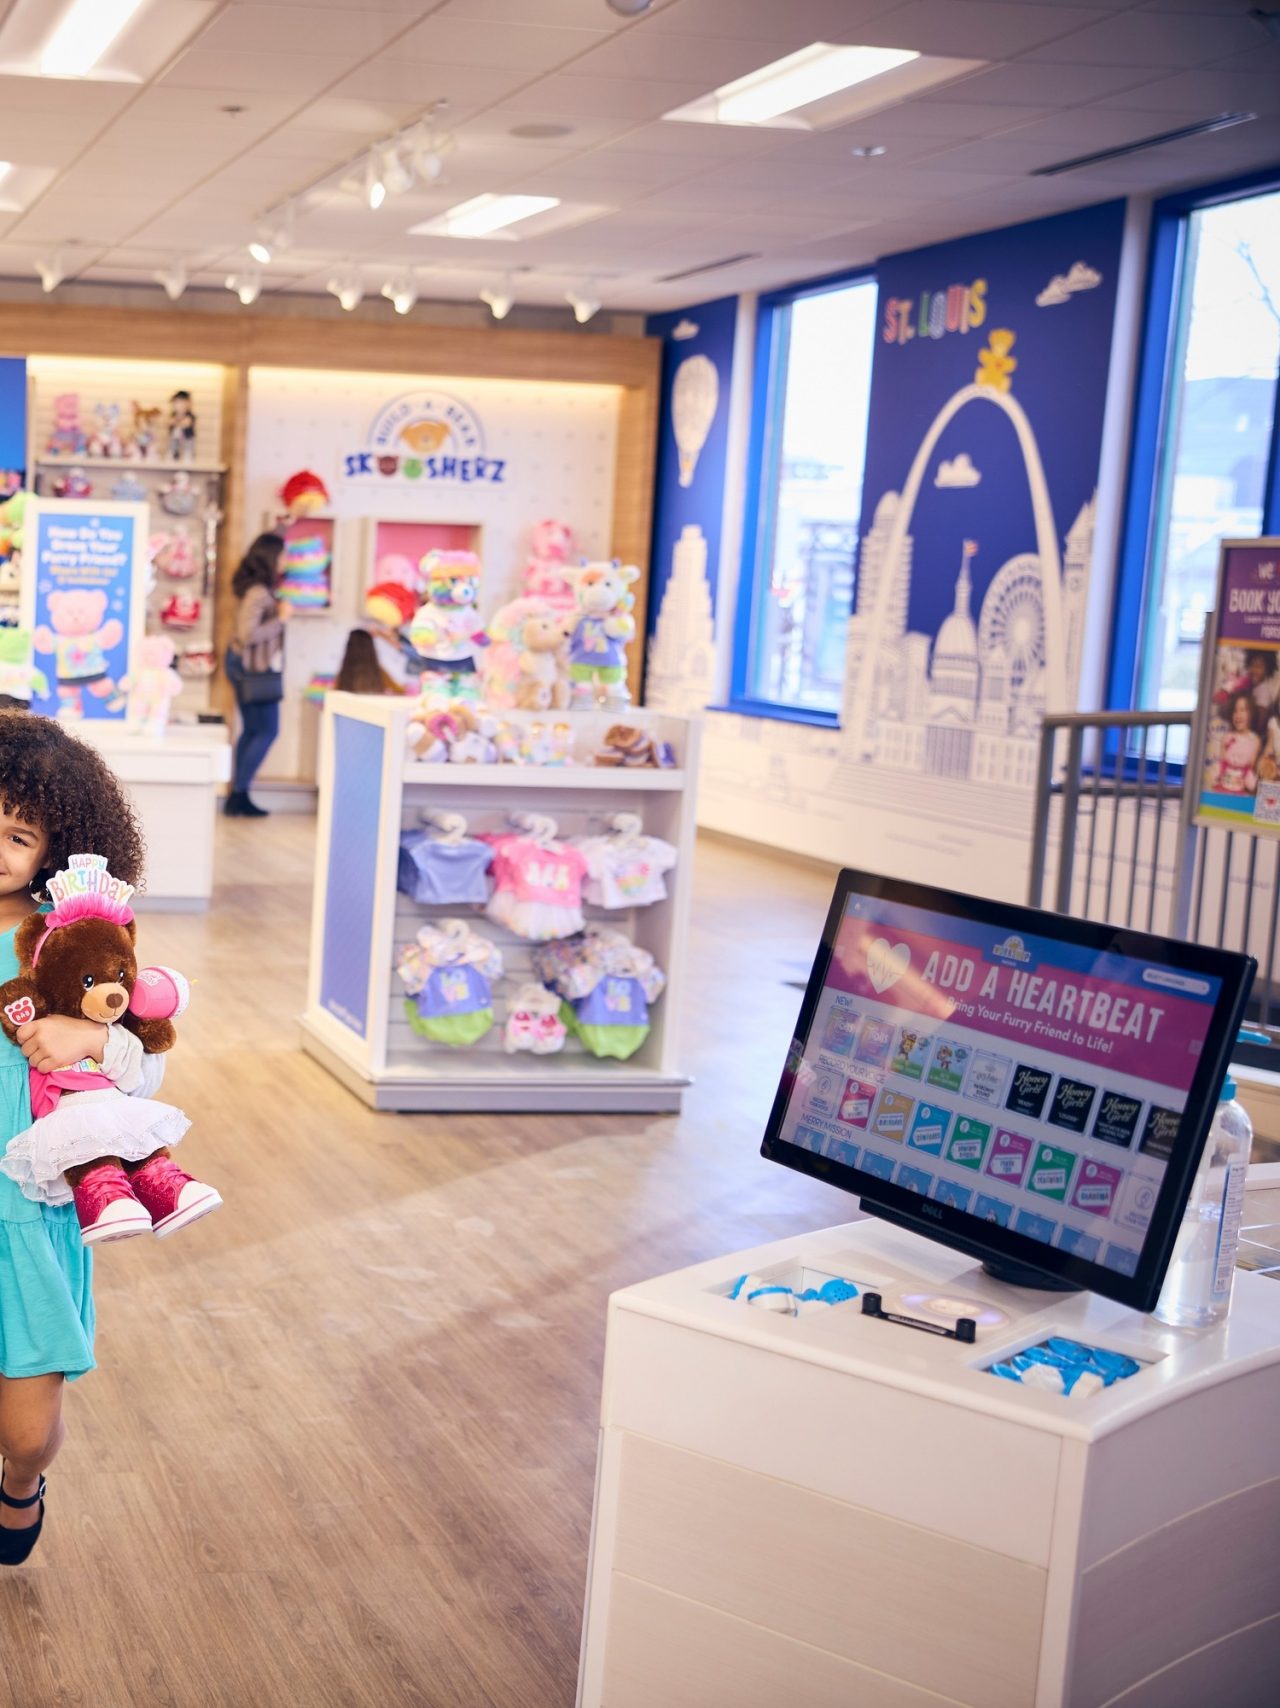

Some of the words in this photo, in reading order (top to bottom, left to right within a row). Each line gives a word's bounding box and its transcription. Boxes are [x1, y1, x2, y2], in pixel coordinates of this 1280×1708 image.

[919, 278, 987, 340] LOUIS
[1228, 587, 1265, 613] BOOK
[920, 950, 975, 993] ADD
[979, 966, 1001, 1000] A
[1006, 969, 1165, 1044] HEARTBEAT
[945, 996, 975, 1018] Bring
[977, 1005, 1001, 1022] Your
[1002, 1012, 1033, 1034] Furry
[1033, 1020, 1071, 1042] Friend
[1072, 1031, 1085, 1045] to
[1086, 1035, 1115, 1054] Life!
[1015, 1070, 1048, 1088] Honey
[1057, 1082, 1093, 1101] Honey
[1101, 1096, 1138, 1115] Honey
[800, 1112, 824, 1128] MERRY
[823, 1120, 853, 1139] MISSION
